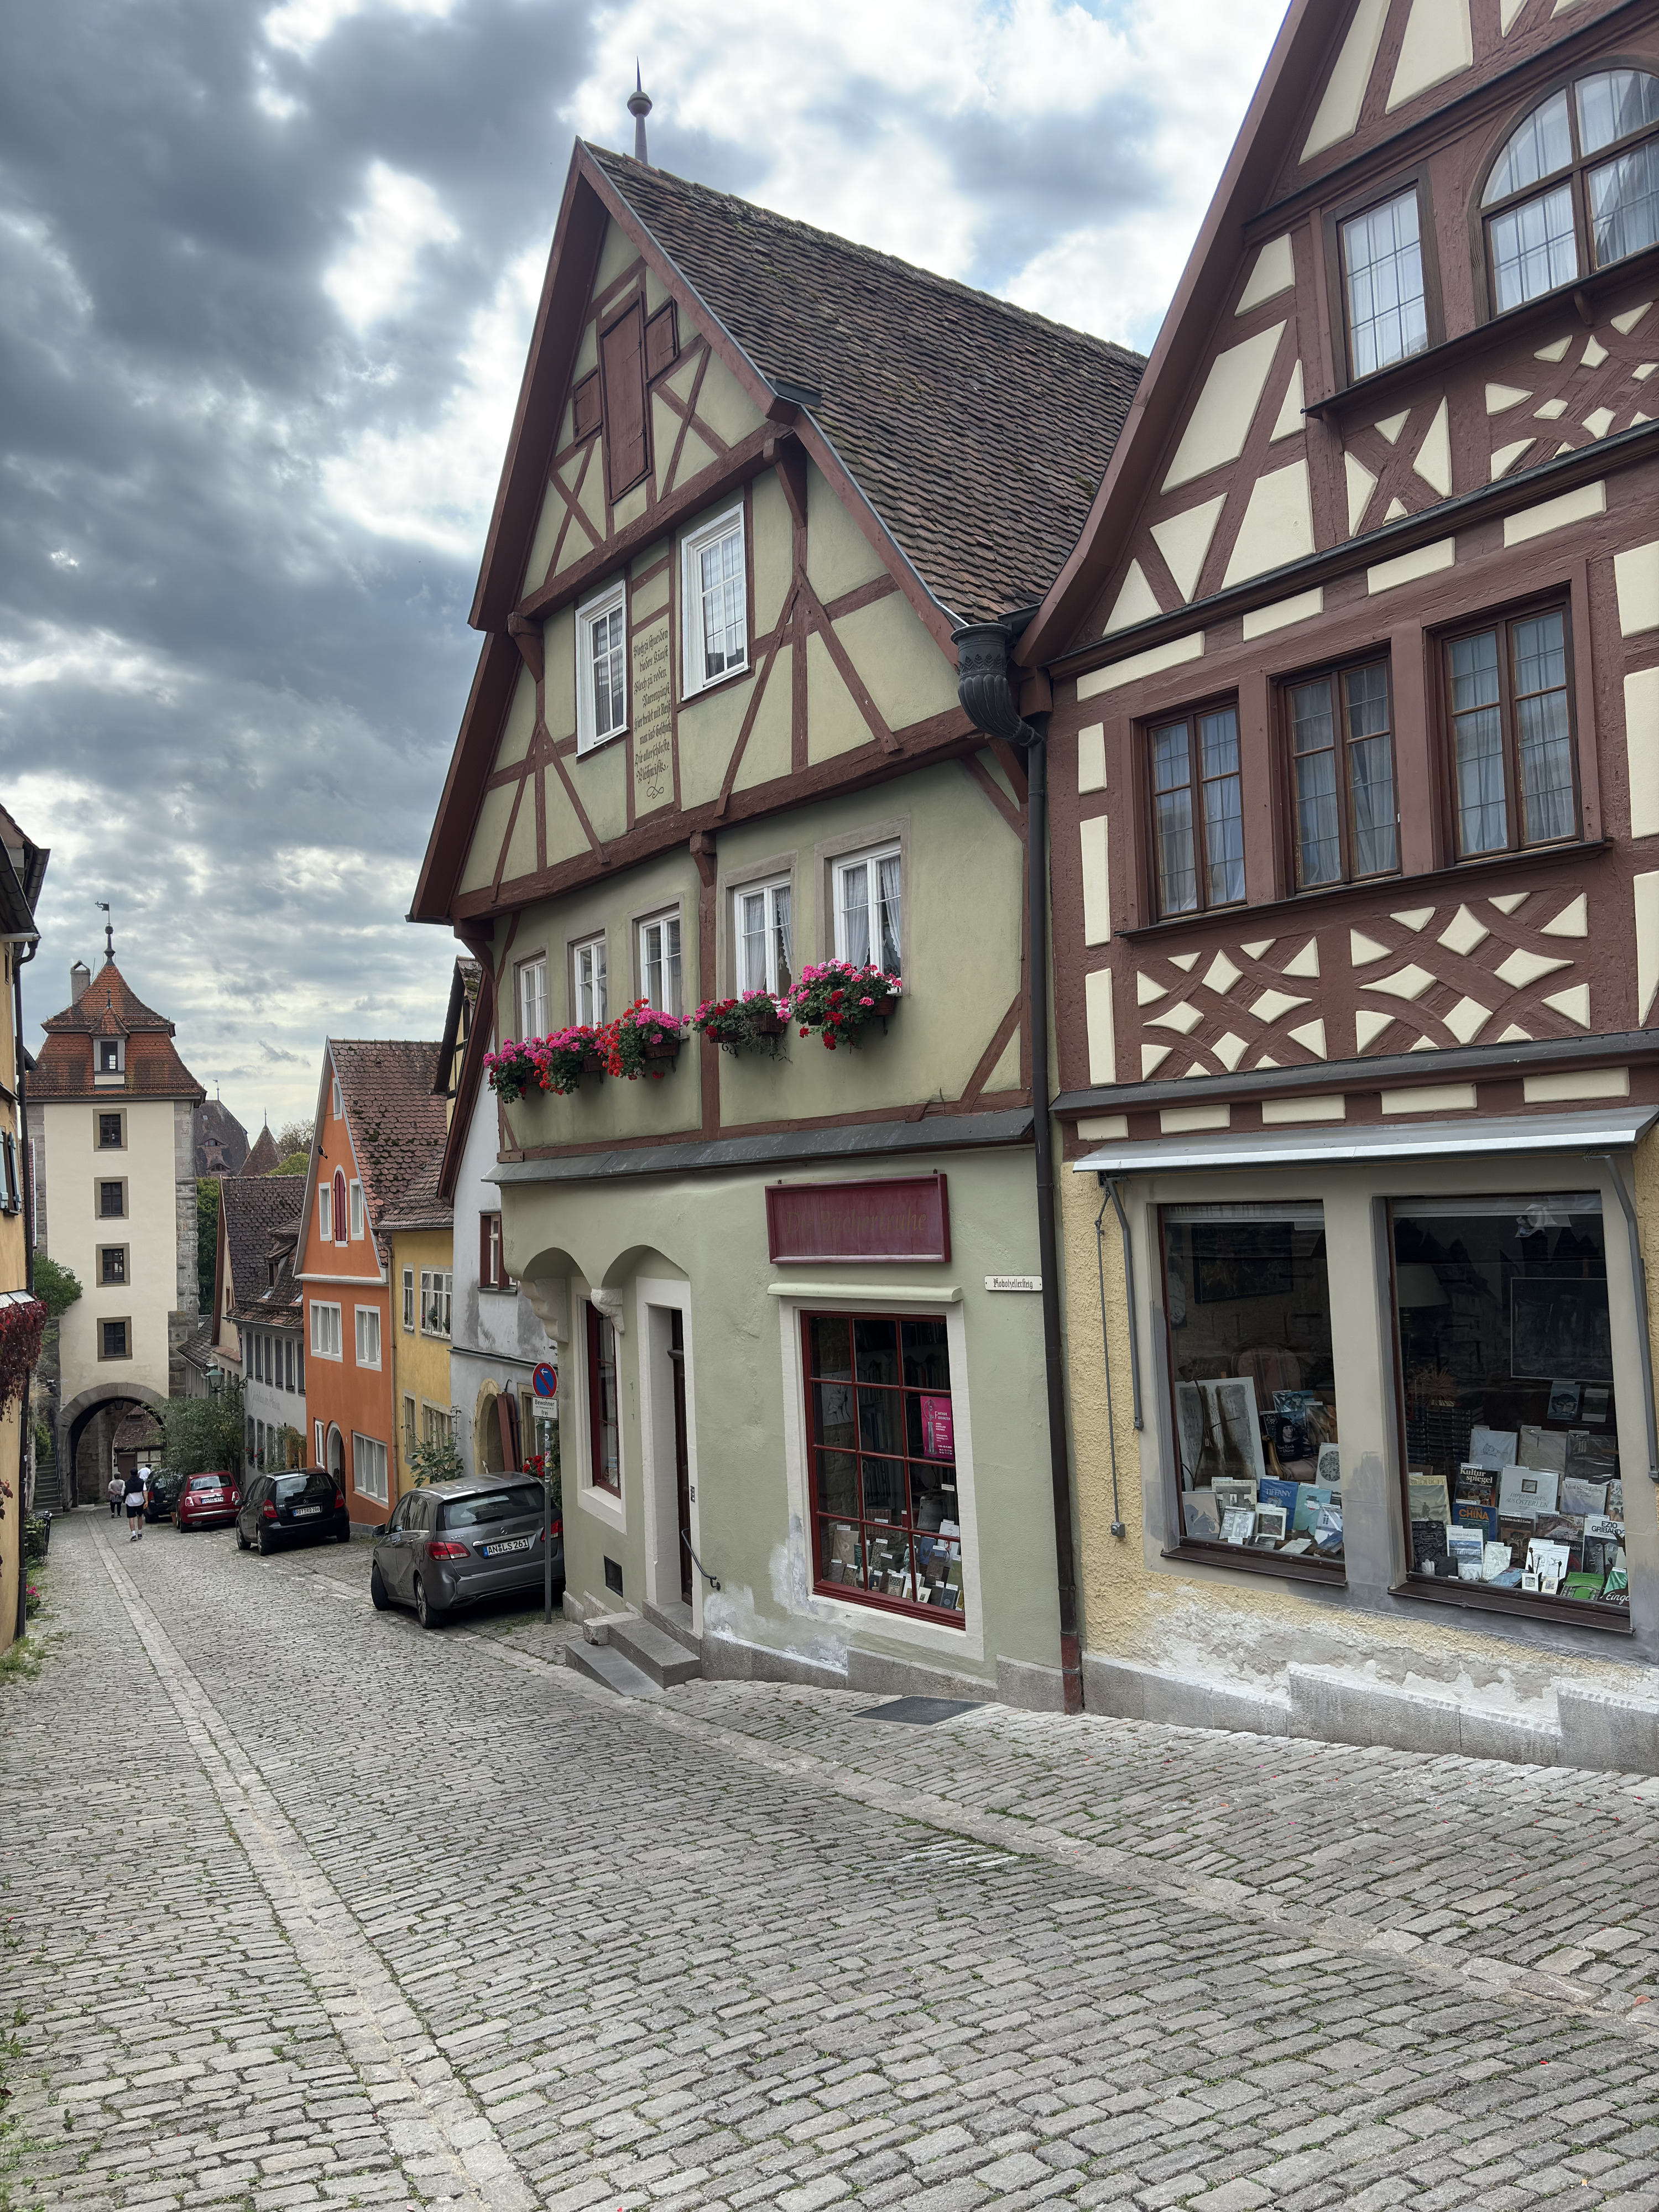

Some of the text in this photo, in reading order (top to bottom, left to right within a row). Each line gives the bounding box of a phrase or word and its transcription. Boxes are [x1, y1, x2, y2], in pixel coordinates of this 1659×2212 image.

[634, 666, 667, 695] Blech zu reden
[821, 1207, 927, 1235] Büchertruhe
[993, 1278, 1033, 1289] Kobolzellersteig
[1460, 1468, 1485, 1477] Kultur
[1466, 1475, 1493, 1484] spiegel
[1265, 1488, 1292, 1497] TIFFANY
[1459, 1509, 1489, 1520] CHINA
[488, 1546, 498, 1554] AN
[502, 1542, 513, 1551] LS
[514, 1540, 528, 1548] 261
